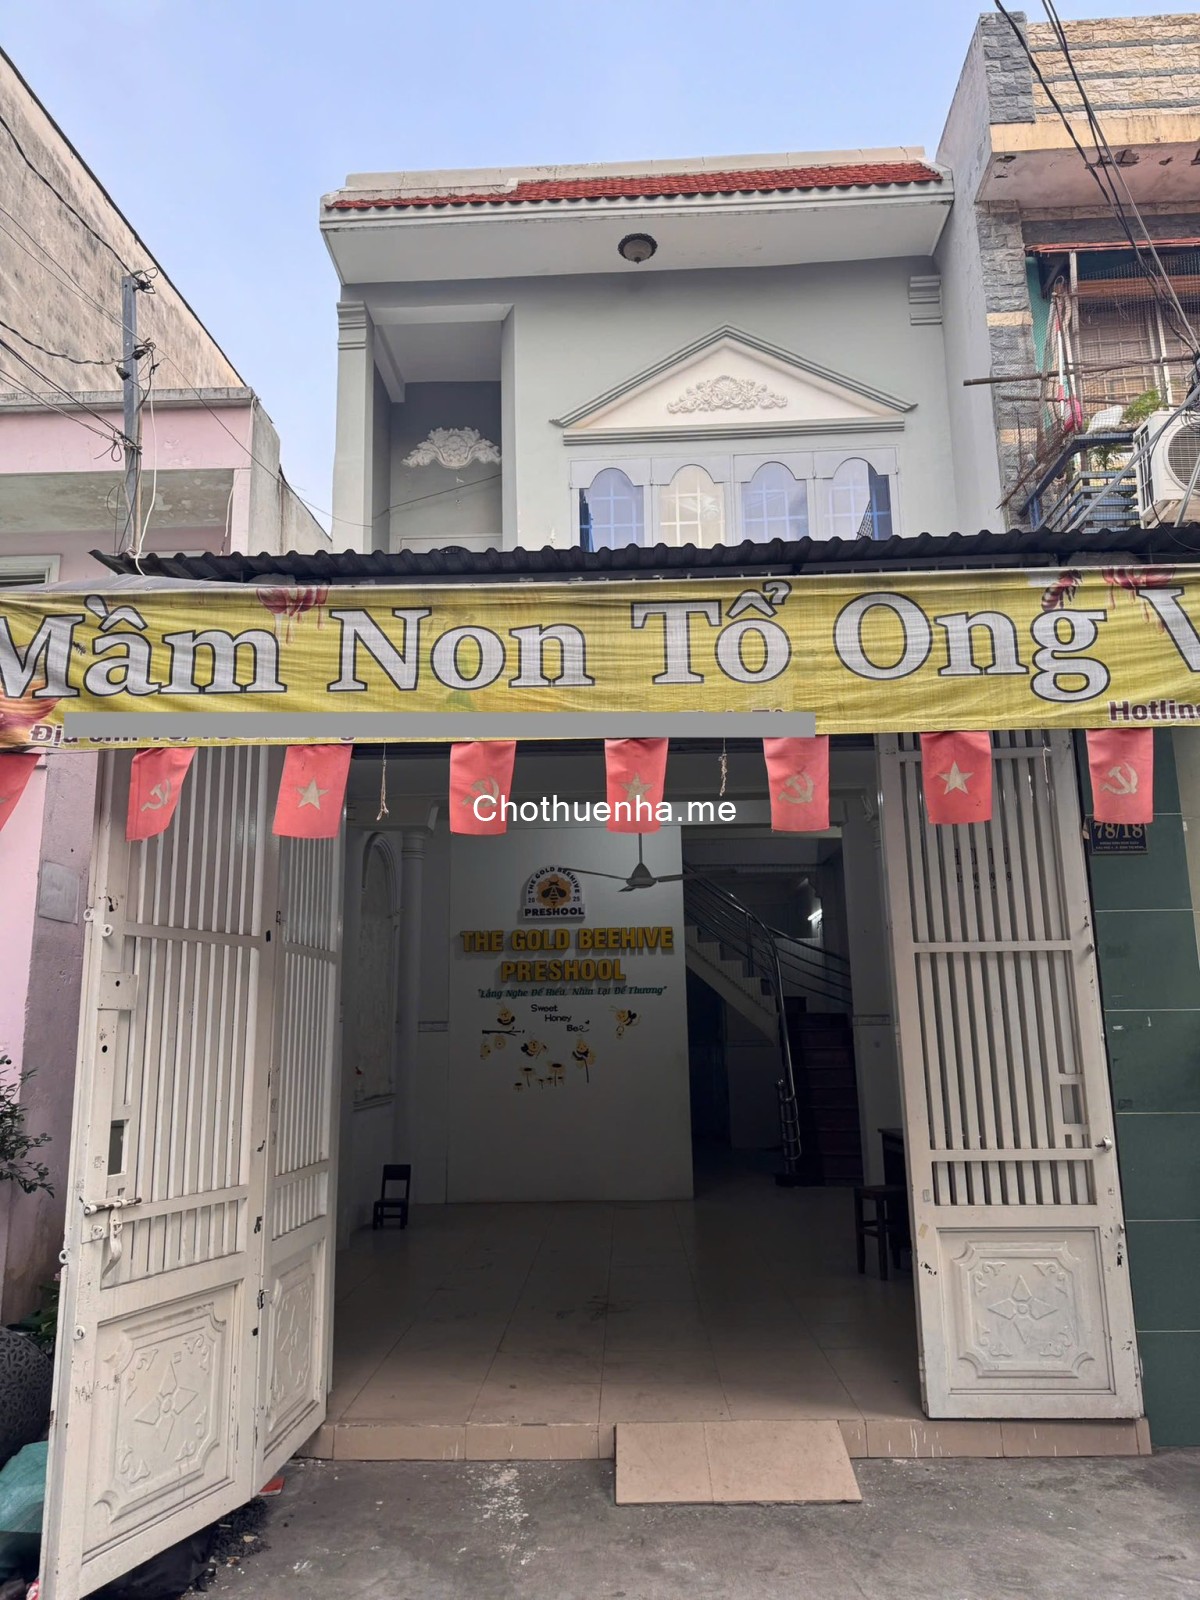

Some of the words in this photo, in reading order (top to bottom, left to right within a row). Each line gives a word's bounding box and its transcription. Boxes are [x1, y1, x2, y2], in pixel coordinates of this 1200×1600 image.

[0, 594, 288, 698] Mầm
[326, 606, 596, 693] Non
[630, 580, 792, 685] Tổ
[832, 591, 1112, 702] Ong
[1109, 699, 1200, 721] Hotlin
[1093, 821, 1143, 839] 78/18
[528, 879, 536, 895] THE
[535, 866, 555, 879] GOLD
[557, 867, 580, 893] BEEHIVE
[524, 907, 584, 917] PRESHOOL
[460, 930, 504, 951] THE
[510, 928, 571, 950] GOLD
[577, 926, 674, 950] BEEHIVE
[501, 958, 627, 983] PRESHOOL
[530, 1003, 558, 1012] Sweet
[544, 1013, 572, 1023] Honey
